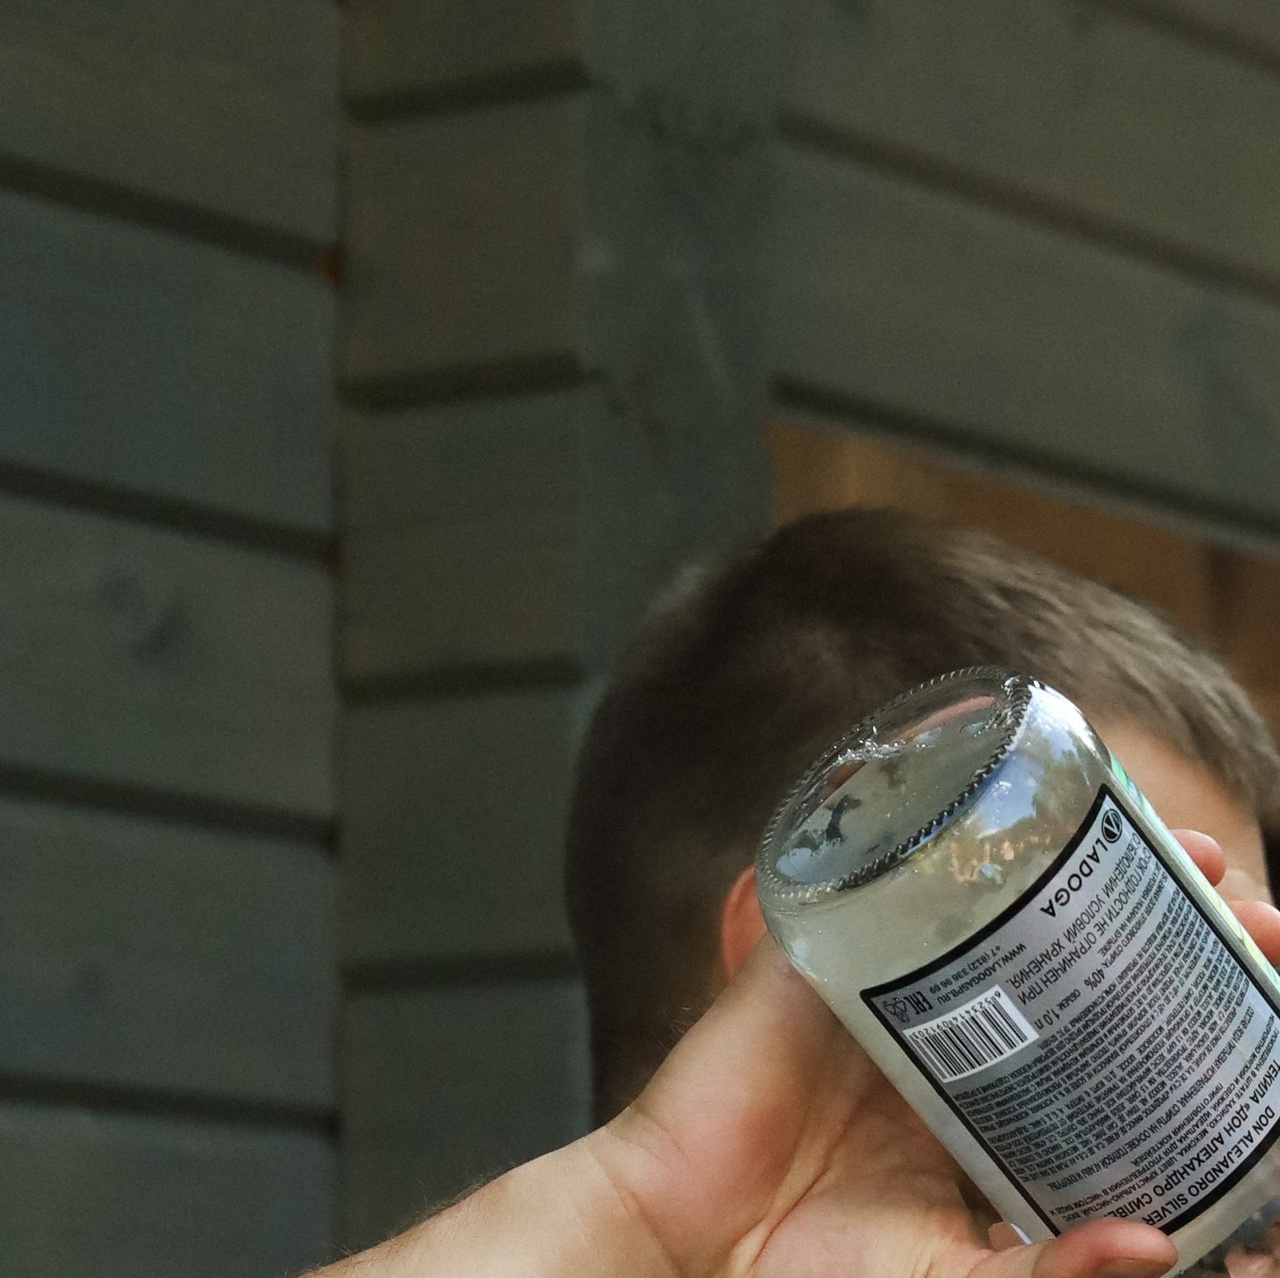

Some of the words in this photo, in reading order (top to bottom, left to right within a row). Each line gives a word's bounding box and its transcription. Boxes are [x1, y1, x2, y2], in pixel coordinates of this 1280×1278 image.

[1098, 831, 1143, 899] СОБЛЮДЕНИИ
[1133, 844, 1154, 875] СРОК
[1038, 834, 1109, 924] LADOGA
[1101, 866, 1143, 924] ГОДНОСТИ
[1061, 891, 1107, 946] УСЛОВИЙ
[1091, 915, 1110, 937] НЕ
[1117, 919, 1129, 934] НА
[933, 940, 1028, 1005] WWW.LADOGASPB.RU
[1004, 936, 1066, 992] ХРАНЕНИЯ.
[1038, 928, 1098, 990] ОГРАНИЧЕН
[1015, 980, 1044, 1006] ПРИ
[1082, 964, 1107, 992] 40%
[1039, 1005, 1062, 1027] 1,0
[1232, 1076, 1240, 1085] И
[1233, 1074, 1254, 1100] ШТАТЕ
[1249, 1069, 1257, 1078] В
[1170, 1081, 1224, 1137] ПРИГОТОВЛЕНИЯ
[1175, 1108, 1212, 1145] ИДЕАЛЬНА
[1205, 1095, 1237, 1131] ХАЛИСКО,
[1220, 1098, 1254, 1137] «ДОН
[1250, 1104, 1276, 1135] DON
[1146, 1121, 1160, 1135] НА
[1148, 1128, 1227, 1200] АЛЕХАНДРО
[1155, 1154, 1178, 1174] ЦВЕТ
[1161, 1140, 1179, 1157] ДЛЯ
[1185, 1128, 1256, 1199] ALEJANDRO
[1100, 1187, 1108, 1195] В
[1106, 1151, 1164, 1195] УПОТРЕБЛЕНИЯ
[1071, 1189, 1102, 1210] ЧИСТОМ
[1102, 1189, 1154, 1227] СИЛВЕ
[1140, 1189, 1190, 1229] SILVER
